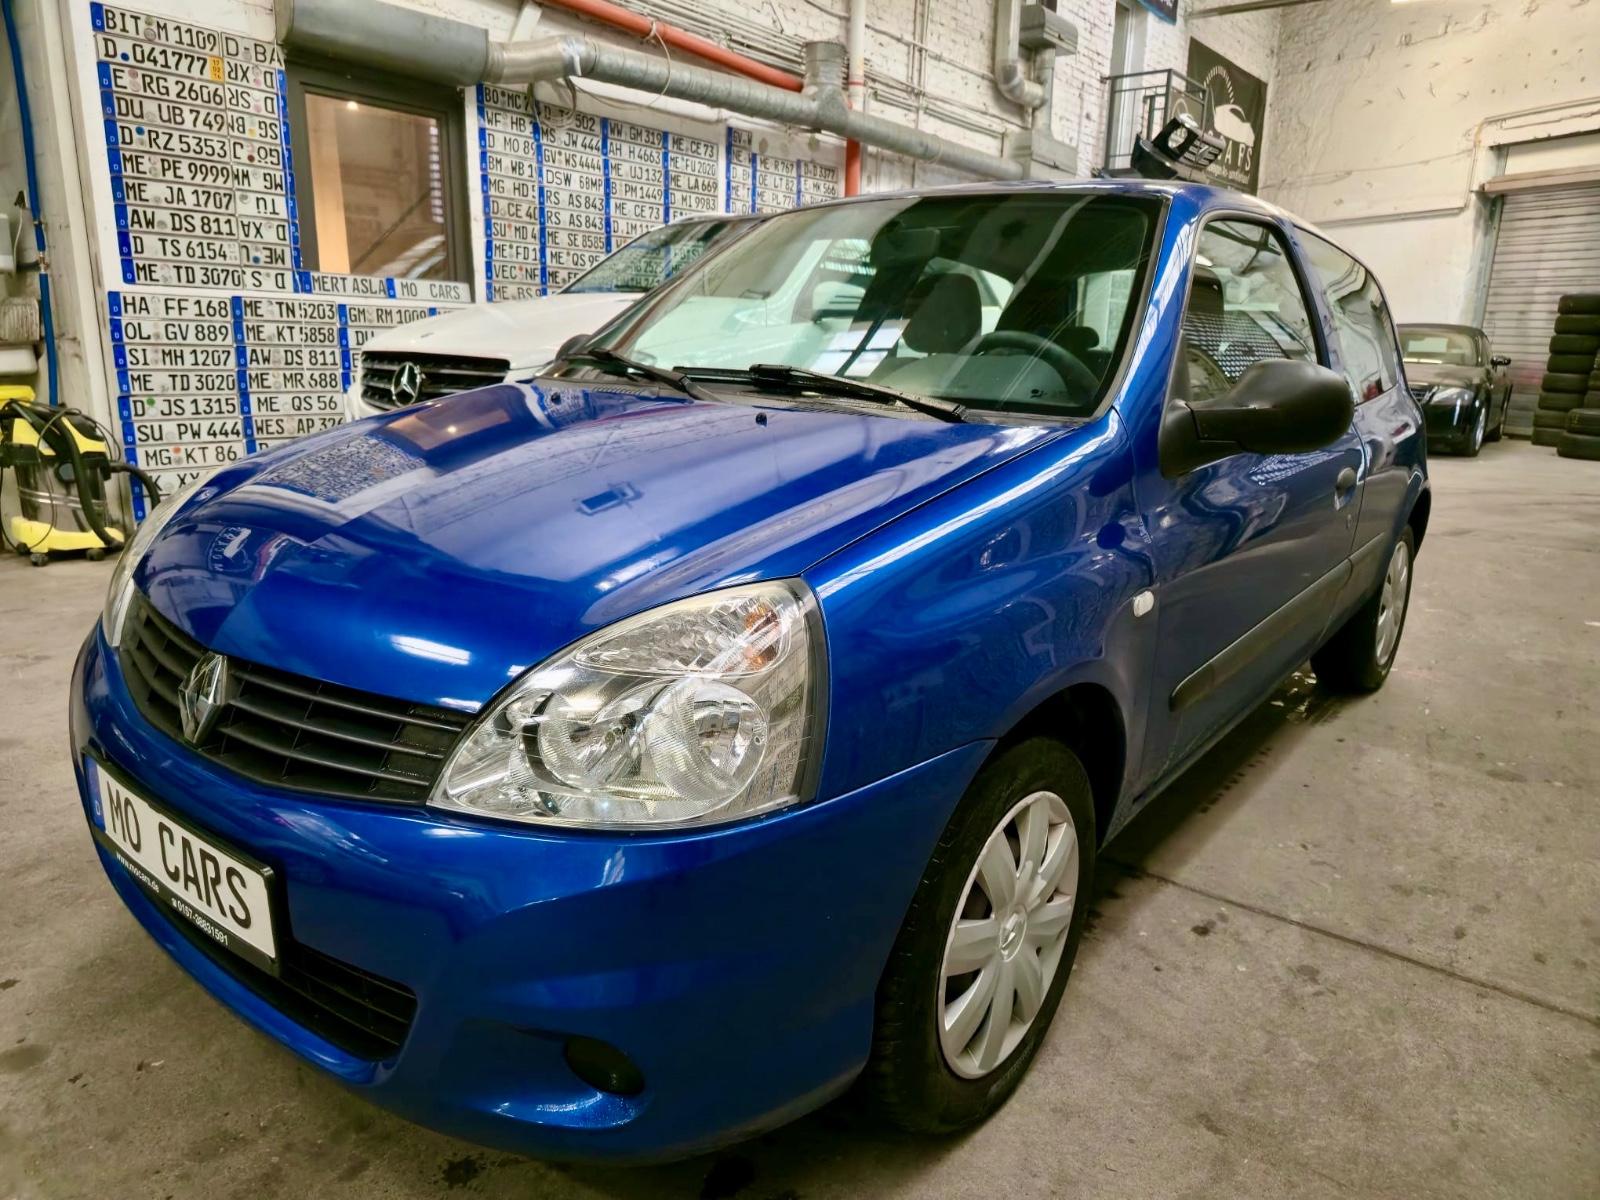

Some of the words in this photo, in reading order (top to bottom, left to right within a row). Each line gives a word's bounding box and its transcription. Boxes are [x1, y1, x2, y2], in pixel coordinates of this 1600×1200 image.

[105, 9, 141, 35] BIT
[157, 21, 169, 42] M
[174, 26, 217, 51] 1109
[103, 37, 117, 58] D
[132, 43, 208, 76] 041777
[113, 68, 127, 90] E
[142, 74, 170, 97] RG
[175, 80, 223, 106] 2606
[485, 87, 499, 104] BO
[507, 93, 521, 109] MC
[115, 96, 144, 119] DU
[158, 103, 185, 125] UB
[189, 108, 225, 132] 749
[486, 110, 501, 127] WF
[511, 116, 526, 132] HB
[576, 114, 595, 131] 502
[119, 125, 133, 145] D
[147, 129, 175, 151] RZ
[179, 134, 227, 158] 5353
[488, 134, 495, 148] D
[504, 136, 519, 152] MO
[542, 127, 555, 143] MS
[564, 132, 578, 147] JW
[644, 129, 662, 146] 319
[672, 135, 684, 151] ME
[690, 140, 702, 155] CE
[704, 144, 714, 158] 73
[544, 149, 556, 164] GV
[565, 152, 577, 168] WS
[609, 141, 622, 157] AH
[629, 145, 635, 159] H
[638, 148, 660, 164] 4663
[121, 152, 147, 175] ME
[160, 158, 184, 179] PE
[188, 162, 231, 185] 9999
[488, 155, 502, 172] BM
[511, 160, 524, 176] WB
[611, 162, 623, 177] ME
[630, 166, 642, 180] UJ
[645, 168, 662, 183] 132
[546, 169, 571, 186] DSW
[670, 174, 682, 188] ME
[687, 177, 699, 190] LA
[125, 181, 149, 202] ME
[164, 185, 187, 206] JA
[192, 189, 232, 210] 1707
[489, 178, 505, 193] MG
[513, 182, 529, 197] HD
[612, 181, 617, 195] B
[625, 183, 637, 198] PM
[640, 186, 662, 201] 1449
[492, 200, 499, 215] D
[508, 202, 523, 218] CE
[546, 190, 560, 205] RS
[568, 193, 582, 208] AS
[585, 195, 604, 211] 843
[546, 210, 561, 225] RS
[569, 213, 582, 228] AS
[585, 215, 604, 230] 843
[615, 202, 627, 216] ME
[634, 204, 647, 218] CE
[649, 206, 660, 220] 73
[130, 208, 155, 230] AW
[170, 212, 196, 233] DS
[200, 216, 236, 237] 811
[493, 222, 506, 237] SU
[515, 225, 527, 240] MD
[613, 220, 619, 233] D
[133, 235, 144, 254] D
[158, 238, 181, 257] TS
[186, 240, 227, 261] 6154
[548, 231, 559, 246] ME
[568, 233, 580, 247] SE
[494, 243, 508, 259] ME
[515, 245, 529, 261] FD
[550, 250, 564, 265] ME
[572, 253, 586, 267] QS
[136, 262, 160, 282] ME
[173, 265, 196, 284] TD
[200, 267, 241, 287] 3070
[493, 264, 517, 280] VEC
[548, 270, 560, 284] ME
[312, 275, 348, 293] MERT
[401, 282, 418, 297] MO
[429, 283, 460, 300] CARS
[494, 286, 510, 300] ME
[123, 296, 150, 315] HA
[164, 298, 189, 316] FF
[194, 300, 229, 318] 168
[244, 300, 264, 317] ME
[275, 302, 296, 318] TN
[299, 303, 335, 319] 5203
[349, 307, 366, 323] GM
[376, 309, 393, 324] RM
[125, 322, 151, 340] OL
[165, 323, 189, 341] GV
[195, 324, 229, 342] 889
[246, 325, 266, 341] ME
[277, 326, 295, 342] KT
[300, 327, 335, 343] 5858
[129, 348, 150, 366] SI
[162, 349, 185, 366] MH
[190, 349, 231, 367] 1207
[250, 349, 271, 365] AW
[284, 350, 303, 366] DS
[309, 350, 338, 366] 811
[130, 374, 154, 391] ME
[168, 375, 190, 391] TD
[194, 375, 235, 391] 3020
[249, 373, 271, 388] ME
[283, 373, 305, 388] MR
[308, 373, 338, 388] 688
[132, 400, 146, 417] D
[160, 399, 186, 417] JS
[191, 398, 236, 415] 1315
[257, 397, 280, 412] ME
[292, 395, 313, 411] QS
[317, 395, 337, 410] 56
[137, 424, 164, 442] SU
[176, 423, 201, 440] PW
[207, 421, 241, 439] 444
[255, 419, 284, 435] WES
[297, 418, 315, 433] AP
[145, 449, 172, 466] MG
[185, 447, 209, 464] KT
[215, 445, 237, 462] 86
[107, 780, 142, 853] MO
[158, 821, 252, 930] CARS
